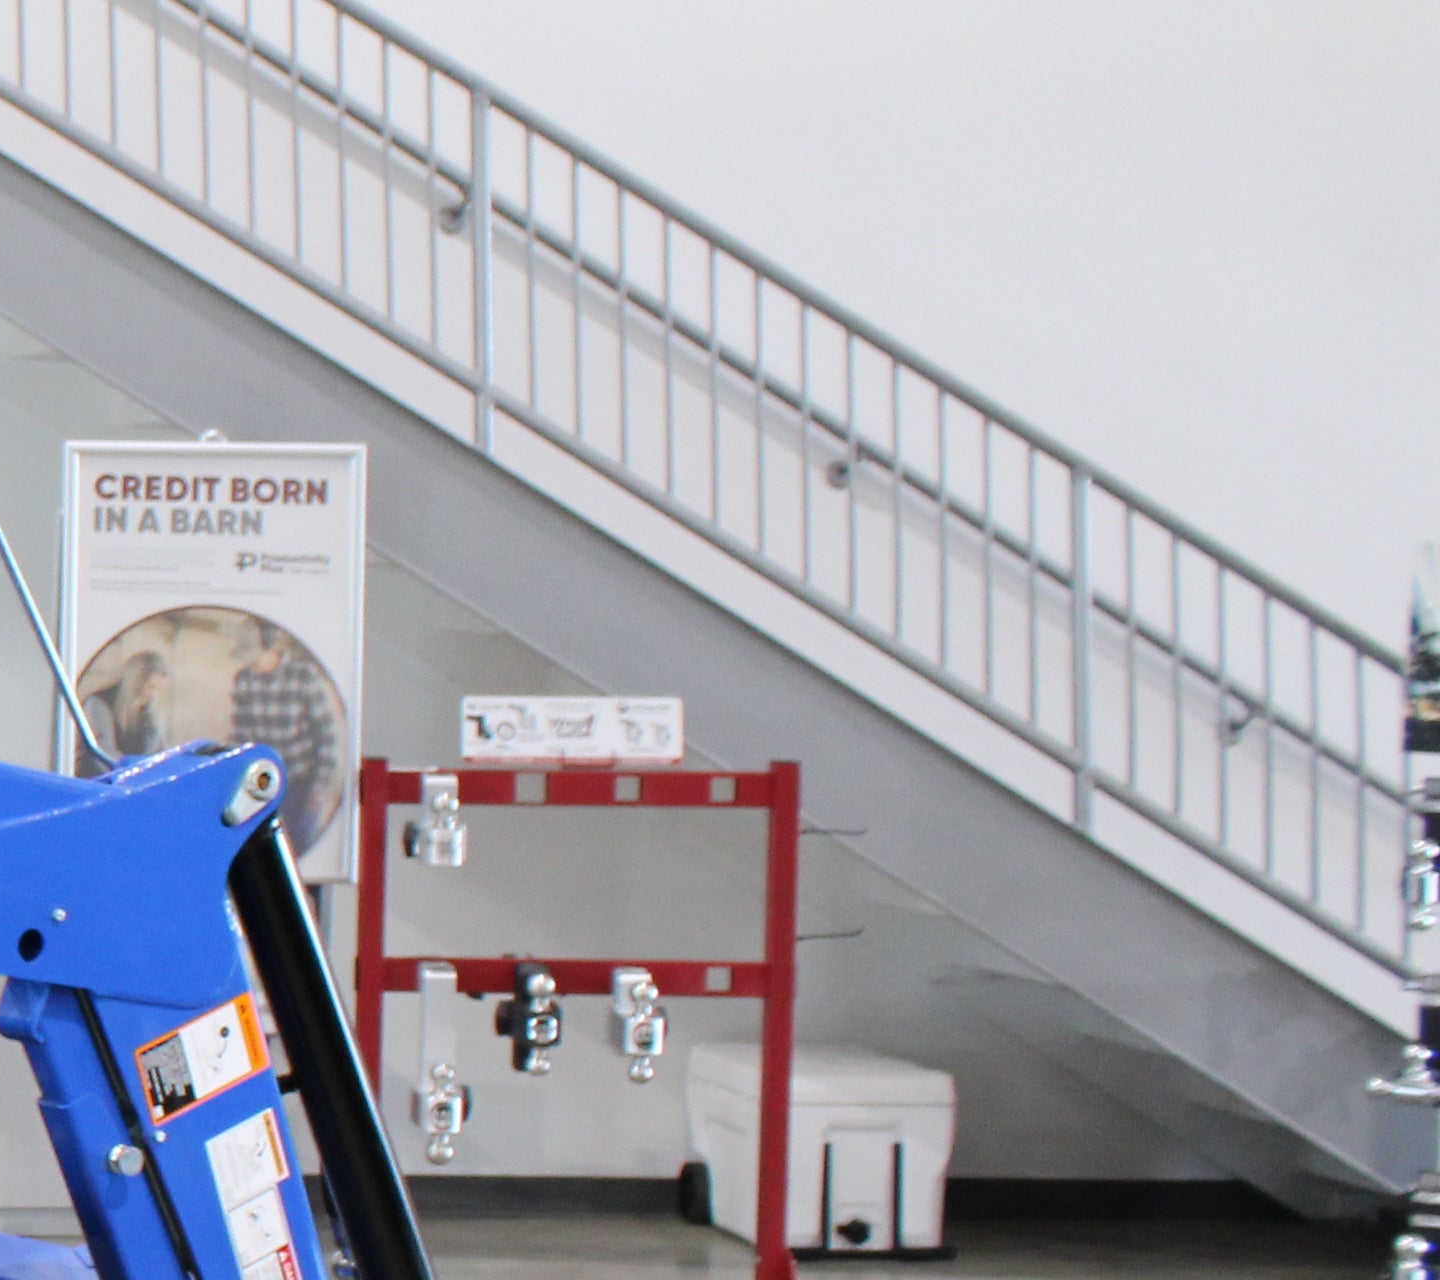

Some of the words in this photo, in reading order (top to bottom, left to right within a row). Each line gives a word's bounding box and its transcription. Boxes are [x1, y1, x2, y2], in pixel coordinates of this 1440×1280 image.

[94, 473, 221, 503] CREDIT
[230, 477, 330, 505] BORN
[92, 506, 128, 533] IN
[136, 508, 161, 534] A
[170, 508, 265, 536] BARN
